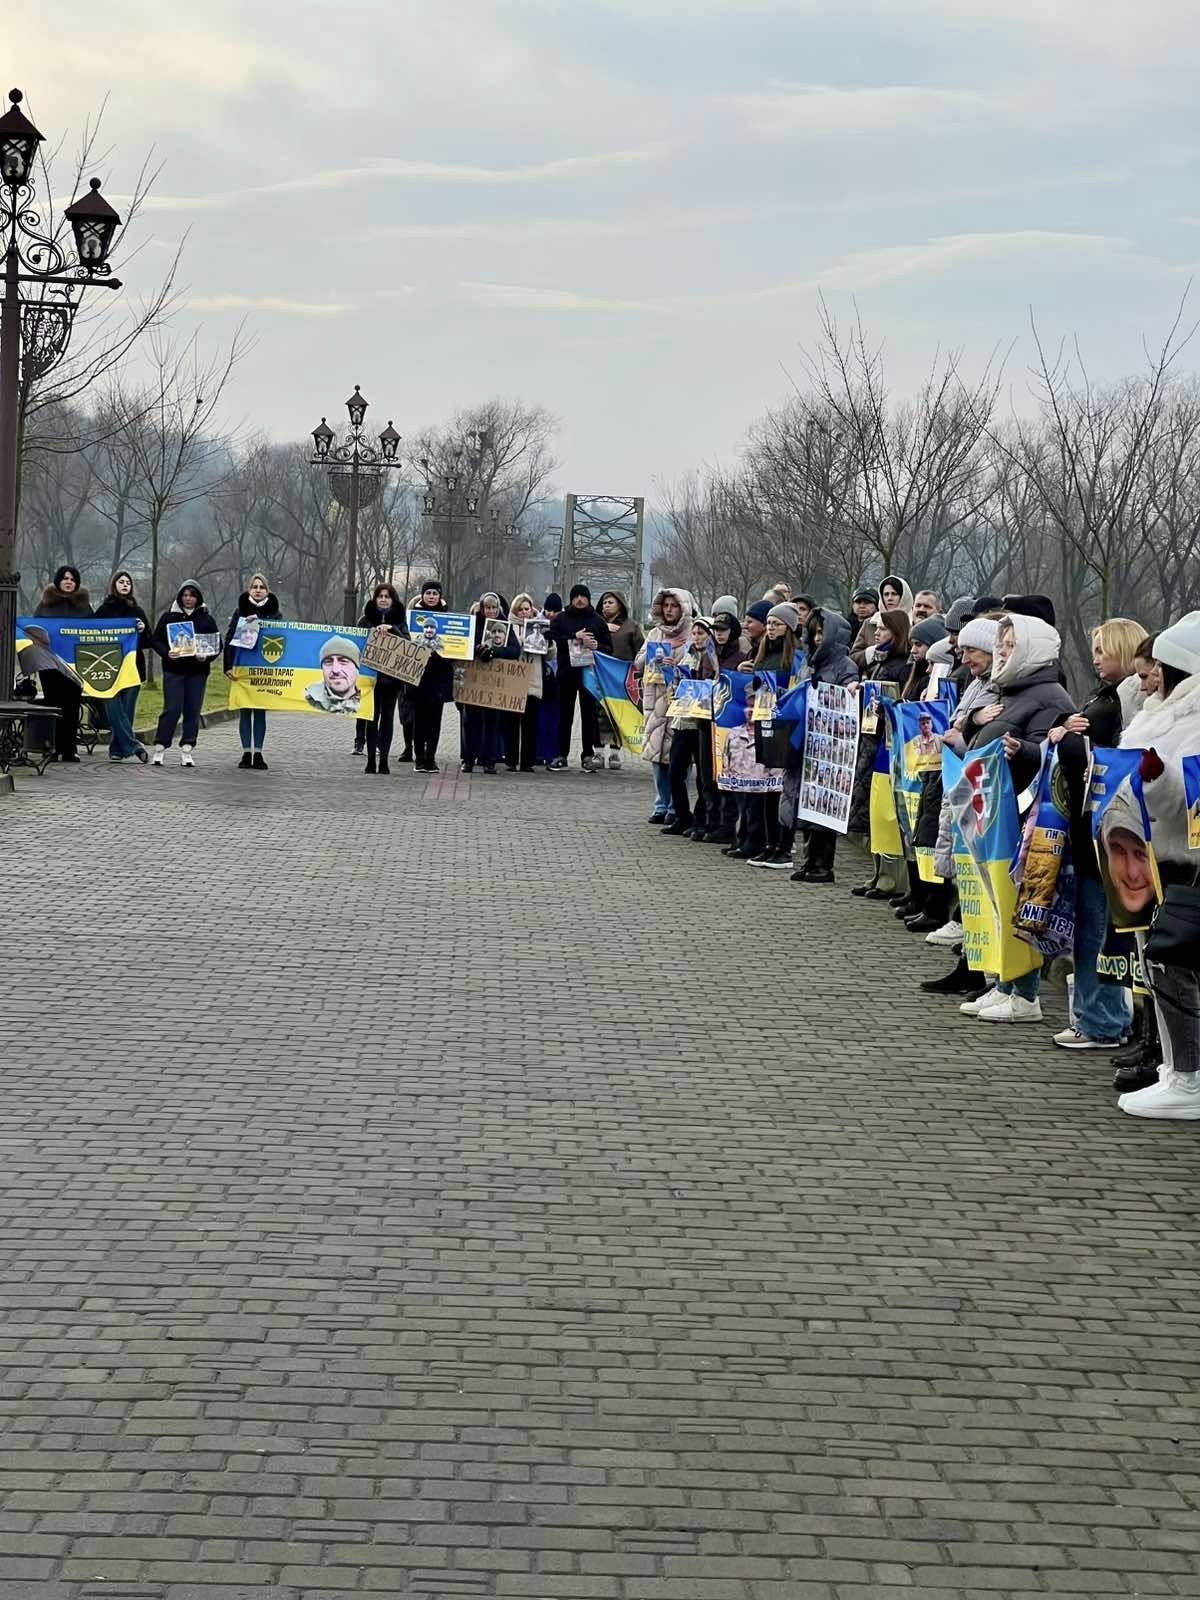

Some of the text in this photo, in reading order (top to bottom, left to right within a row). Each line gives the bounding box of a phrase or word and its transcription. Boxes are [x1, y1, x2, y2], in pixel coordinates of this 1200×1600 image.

[91, 671, 111, 680] 225
[248, 667, 295, 677] ПЕТРАШ ТАРАС
[250, 677, 292, 687] МИХАЙЛОВИЧ
